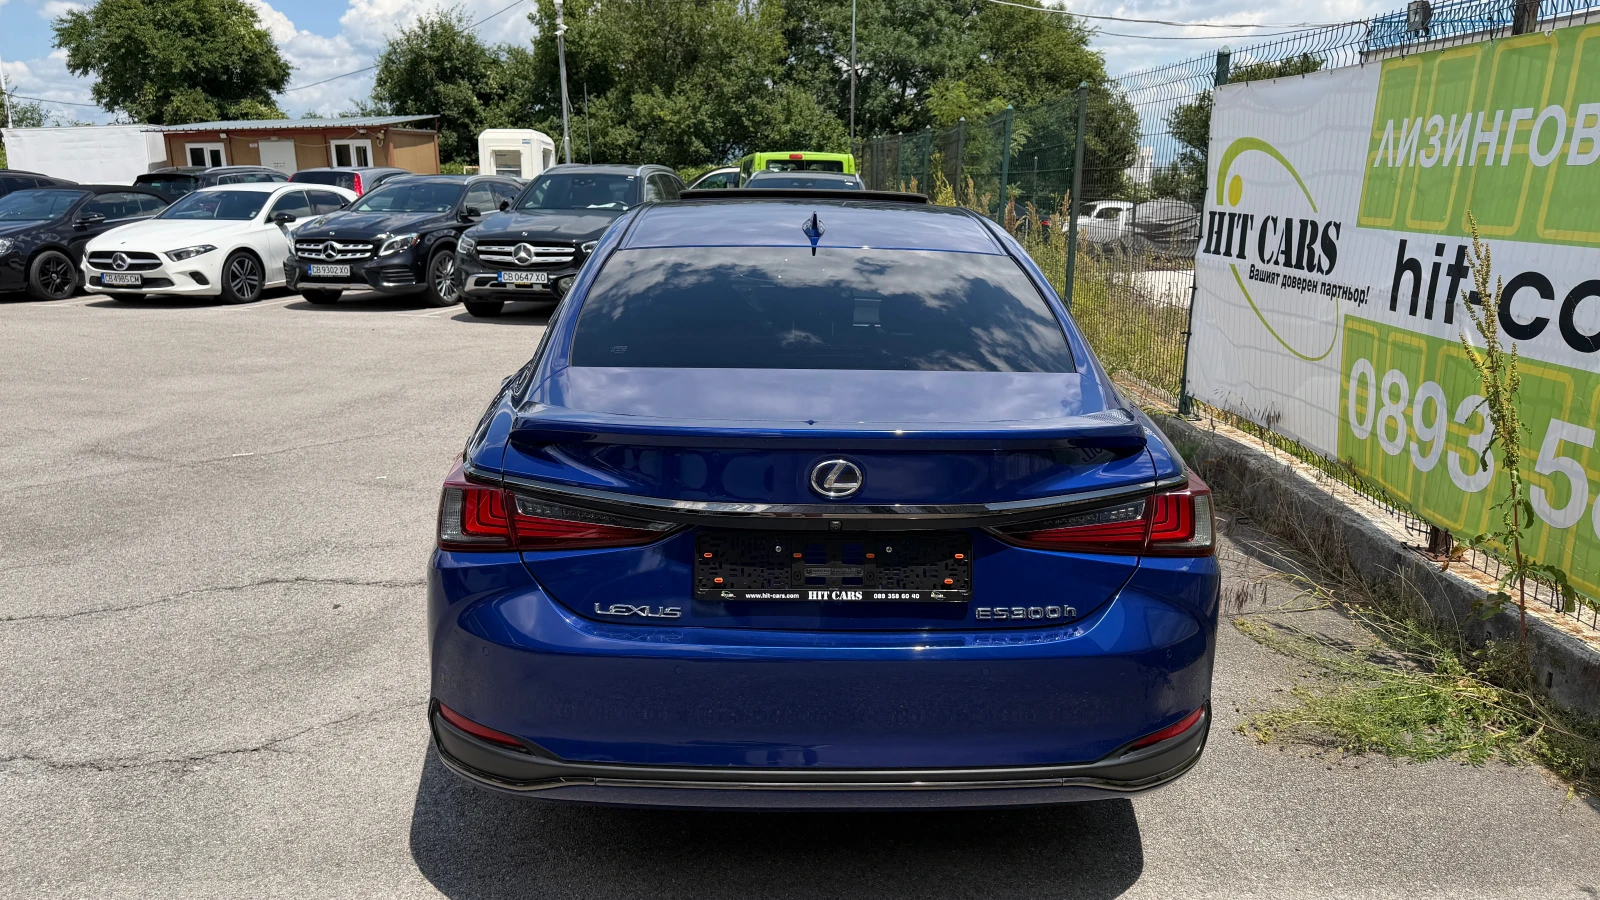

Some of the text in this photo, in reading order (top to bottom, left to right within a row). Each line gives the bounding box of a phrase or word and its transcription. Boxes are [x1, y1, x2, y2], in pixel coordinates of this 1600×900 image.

[1373, 102, 1600, 168] ЛИЗИНГОВ
[1202, 210, 1342, 276] HIT CARS
[514, 272, 534, 281] 0647
[1248, 263, 1371, 308] Вашият доверен партньор!
[1349, 358, 1600, 541] 0893 5
[594, 602, 682, 618] LEXUS
[807, 590, 830, 600] HIT
[831, 590, 863, 601] CARS
[975, 604, 1077, 620] ES300h
